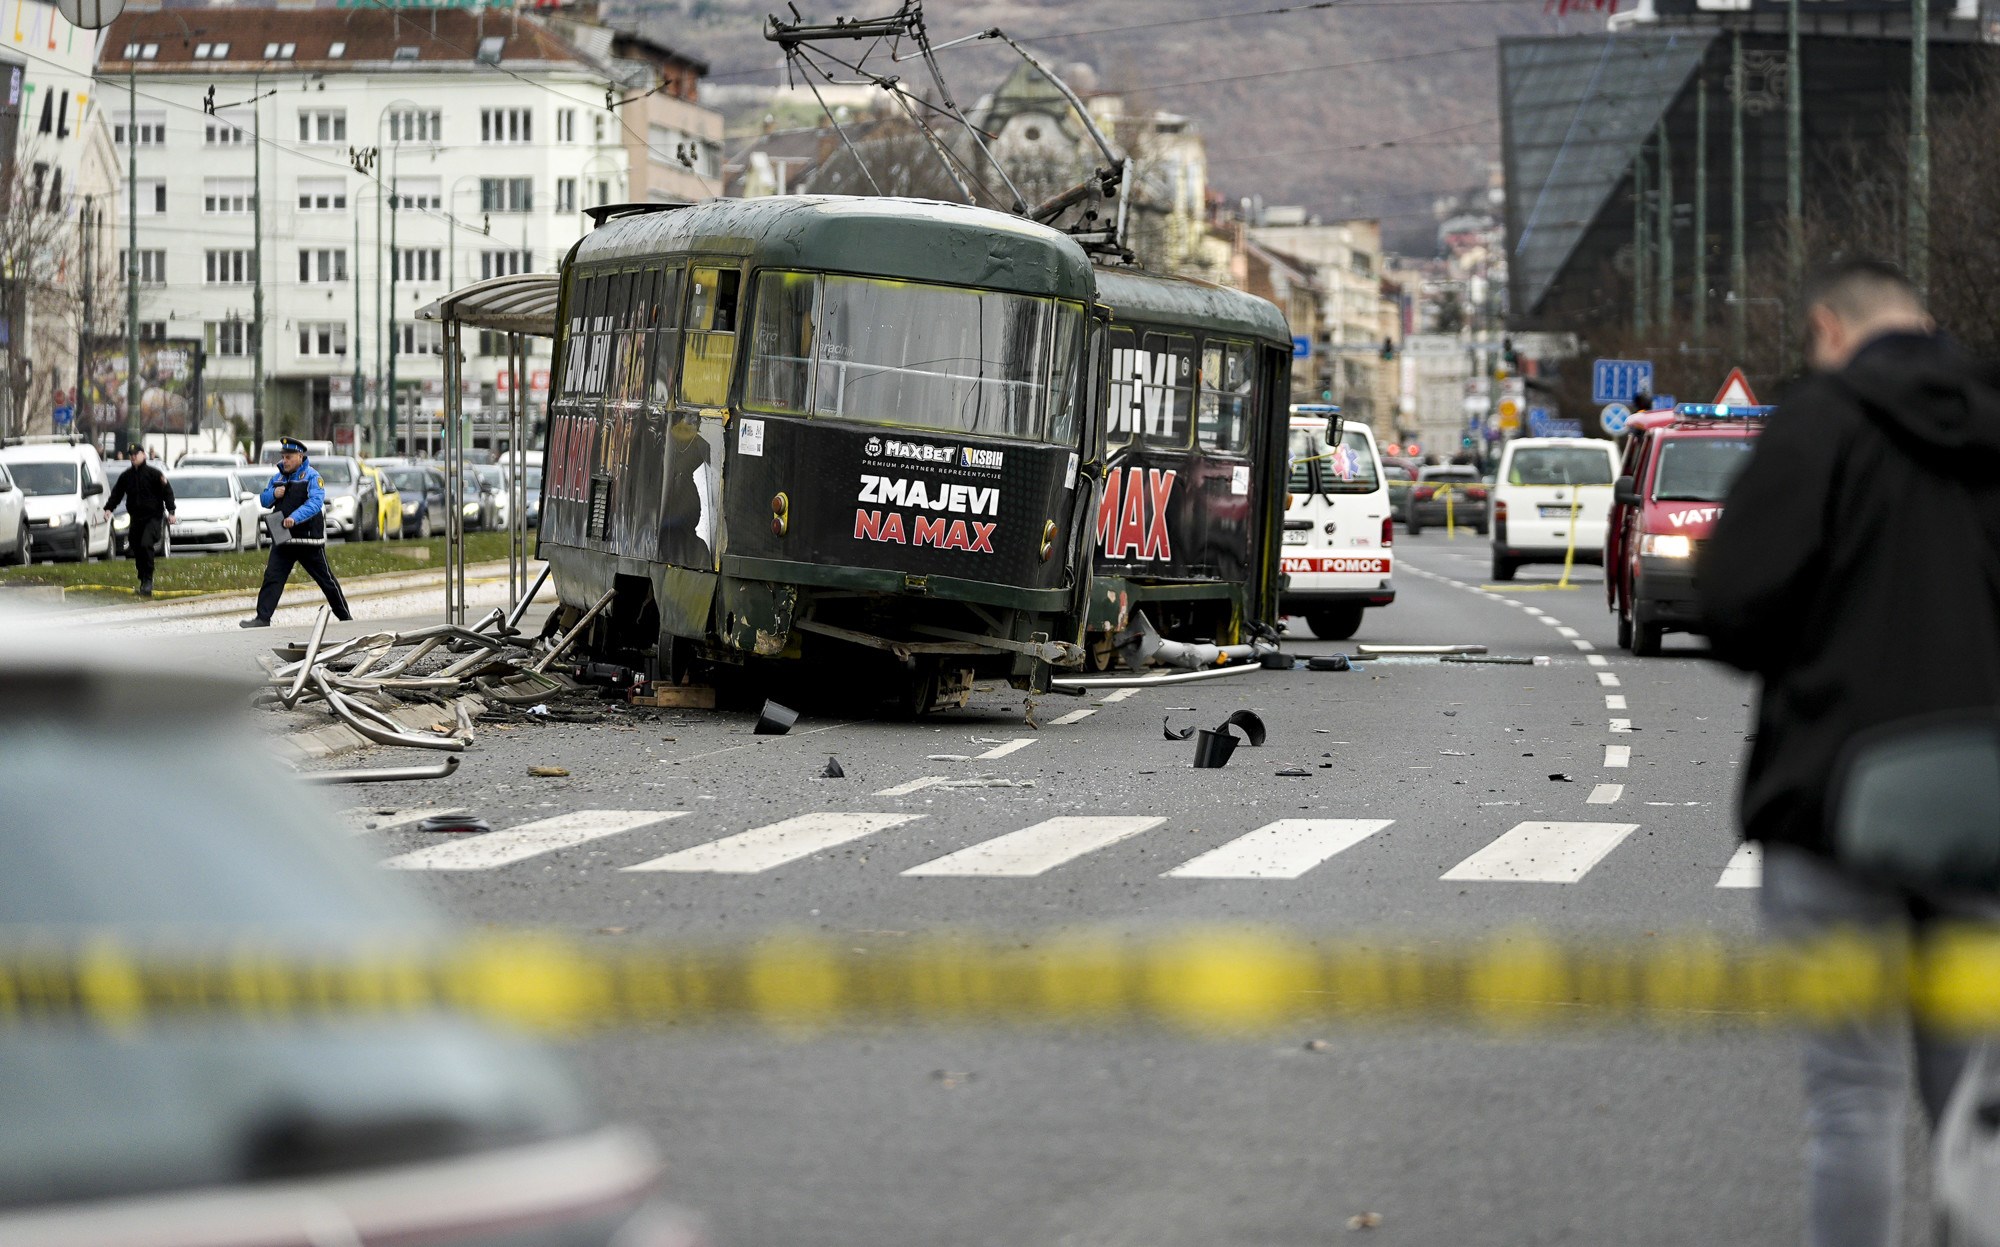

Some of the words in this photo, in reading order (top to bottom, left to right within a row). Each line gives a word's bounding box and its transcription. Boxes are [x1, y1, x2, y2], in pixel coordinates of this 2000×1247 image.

[862, 459, 897, 468] PREMIUM
[900, 463, 935, 473] PARTNER
[938, 467, 1002, 480] REPREZENTACIJE
[971, 449, 1004, 467] KSBIH
[858, 474, 1000, 516] ZMAJEVI
[1096, 466, 1177, 562] MAX
[854, 508, 906, 545] NA
[913, 515, 997, 554] MAX
